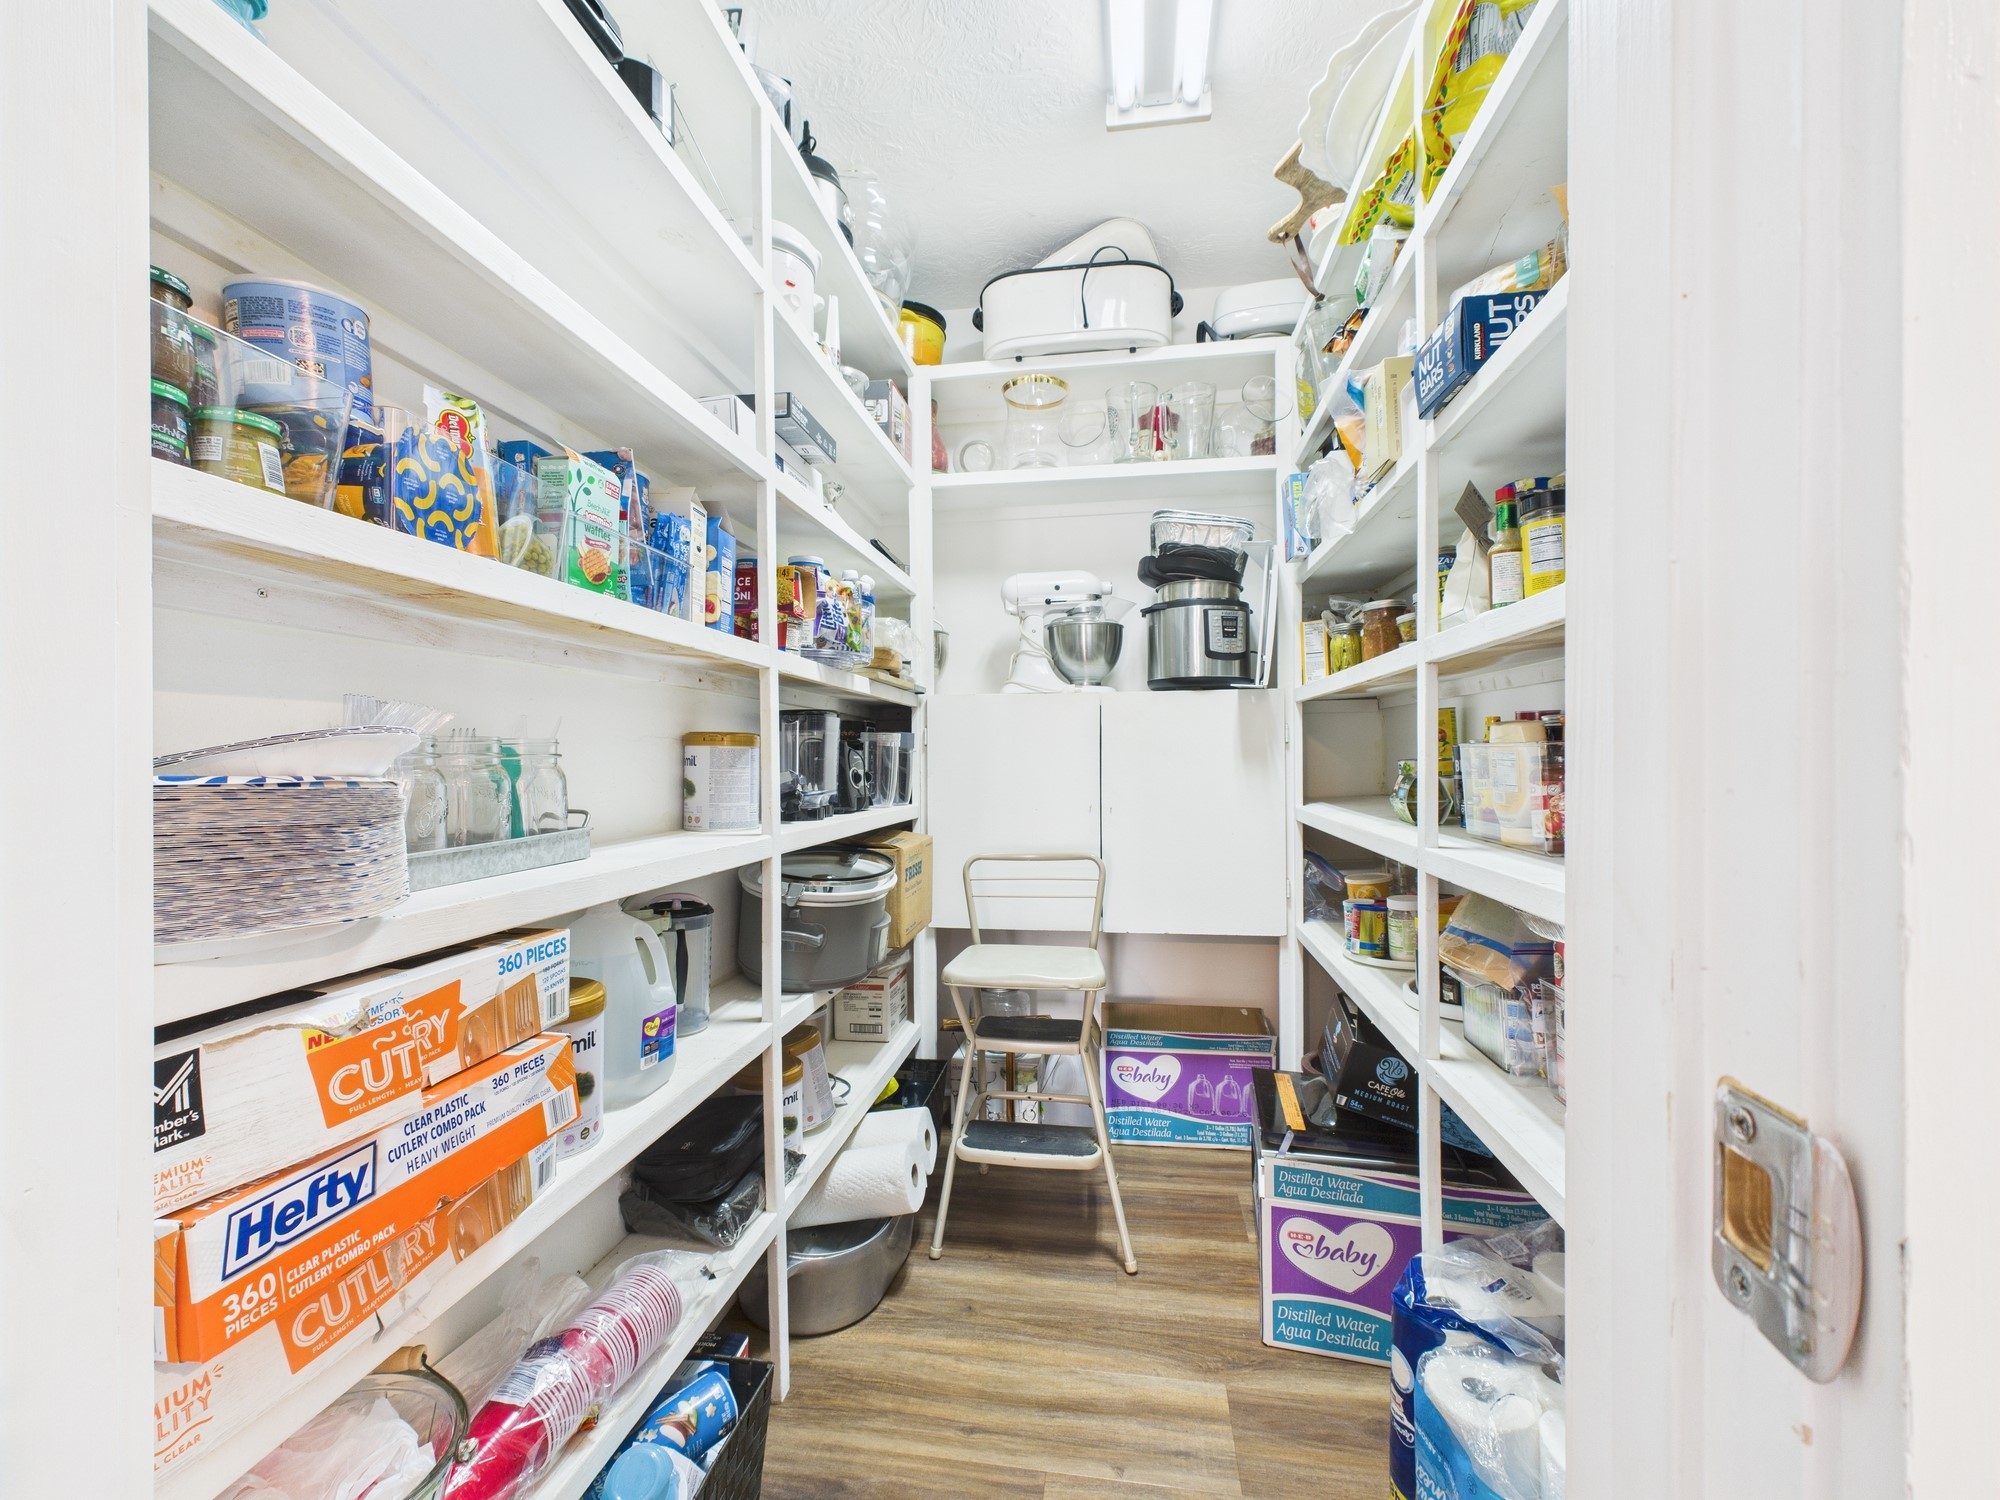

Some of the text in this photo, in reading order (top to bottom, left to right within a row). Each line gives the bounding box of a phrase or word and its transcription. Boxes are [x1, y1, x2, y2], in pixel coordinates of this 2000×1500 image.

[1473, 322, 1481, 360] KIRKLAND
[1418, 338, 1443, 381] NUT
[1419, 361, 1444, 399] BARS
[448, 414, 460, 429] Del
[498, 936, 567, 976] 360 PIECES
[1109, 1033, 1163, 1042] Distilled Water
[1130, 1039, 1163, 1047] Destilada
[491, 1054, 545, 1090] 360 PIECES
[1132, 1066, 1172, 1091] baby
[1367, 1080, 1390, 1094] CAFE
[348, 1088, 395, 1114] FULL LENGTH
[403, 1093, 470, 1137] CLEAR PLASTIC
[486, 1086, 552, 1129] PREMIUM QUALITY CRYSTAL CLEAR
[1353, 1088, 1383, 1103] MEDIUM
[1386, 1099, 1411, 1112] ROAST
[154, 1110, 200, 1133] mber's
[387, 1100, 487, 1164] CUTLERY COMBO PACK
[1108, 1115, 1172, 1128] Distilled Water
[1108, 1126, 1172, 1138] Agua Destilada
[406, 1125, 477, 1175] HEAVY WEIGHT
[154, 1158, 204, 1185] EMIUM
[154, 1168, 205, 1196] ALITY
[1278, 1170, 1364, 1192] Distilled Water
[1277, 1184, 1364, 1204] Agua Destilada
[235, 1161, 369, 1262] Hefty
[286, 1229, 361, 1284] CLEAR PLASTIC
[288, 1223, 396, 1299] CUTLERY COMBO PACK
[1314, 1234, 1377, 1277] baby
[221, 1272, 277, 1324] 360
[224, 1296, 279, 1340] PIECES
[1277, 1305, 1380, 1335] Distilled Water
[312, 1338, 329, 1354] FULL
[329, 1317, 355, 1341] LENGTH
[1276, 1322, 1380, 1352] Agua Destilada
[163, 1434, 202, 1464] CLEAR
